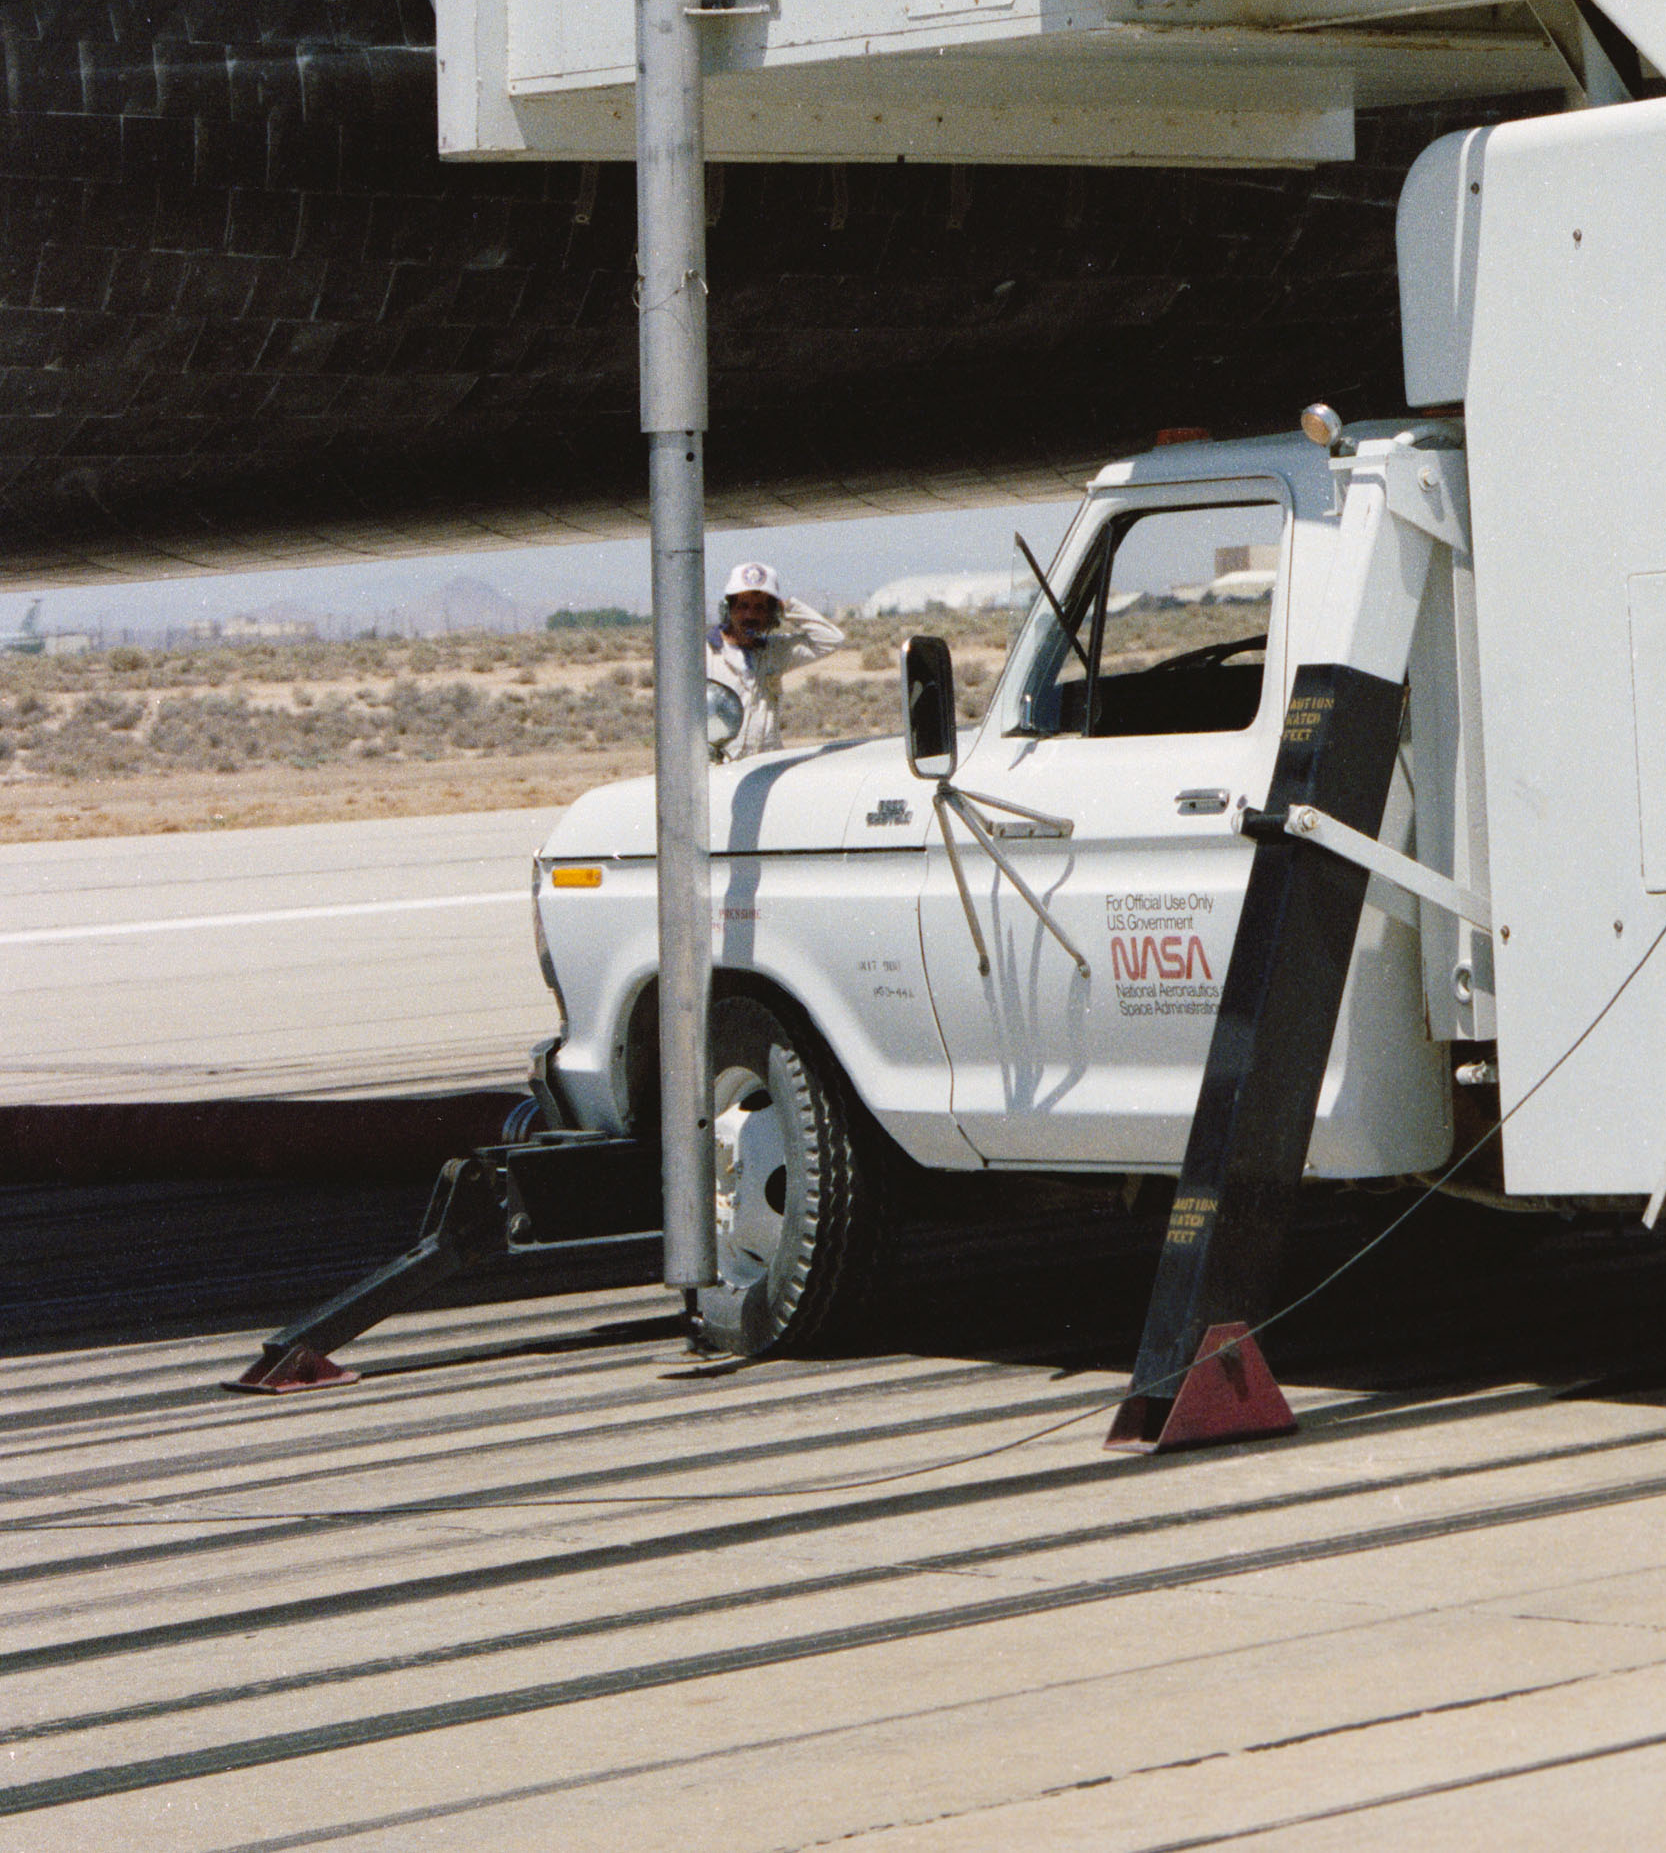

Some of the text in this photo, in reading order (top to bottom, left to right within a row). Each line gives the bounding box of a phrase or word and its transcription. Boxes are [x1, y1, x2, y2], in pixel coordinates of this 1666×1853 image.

[1290, 697, 1335, 709] AUTION
[1106, 892, 1214, 914] For Official Use Only
[1111, 935, 1213, 981] NASA
[1116, 983, 1157, 998] National
[1160, 983, 1219, 998] Aeronautics
[1119, 1000, 1153, 1016] Space
[1172, 1197, 1218, 1211] AUTION
